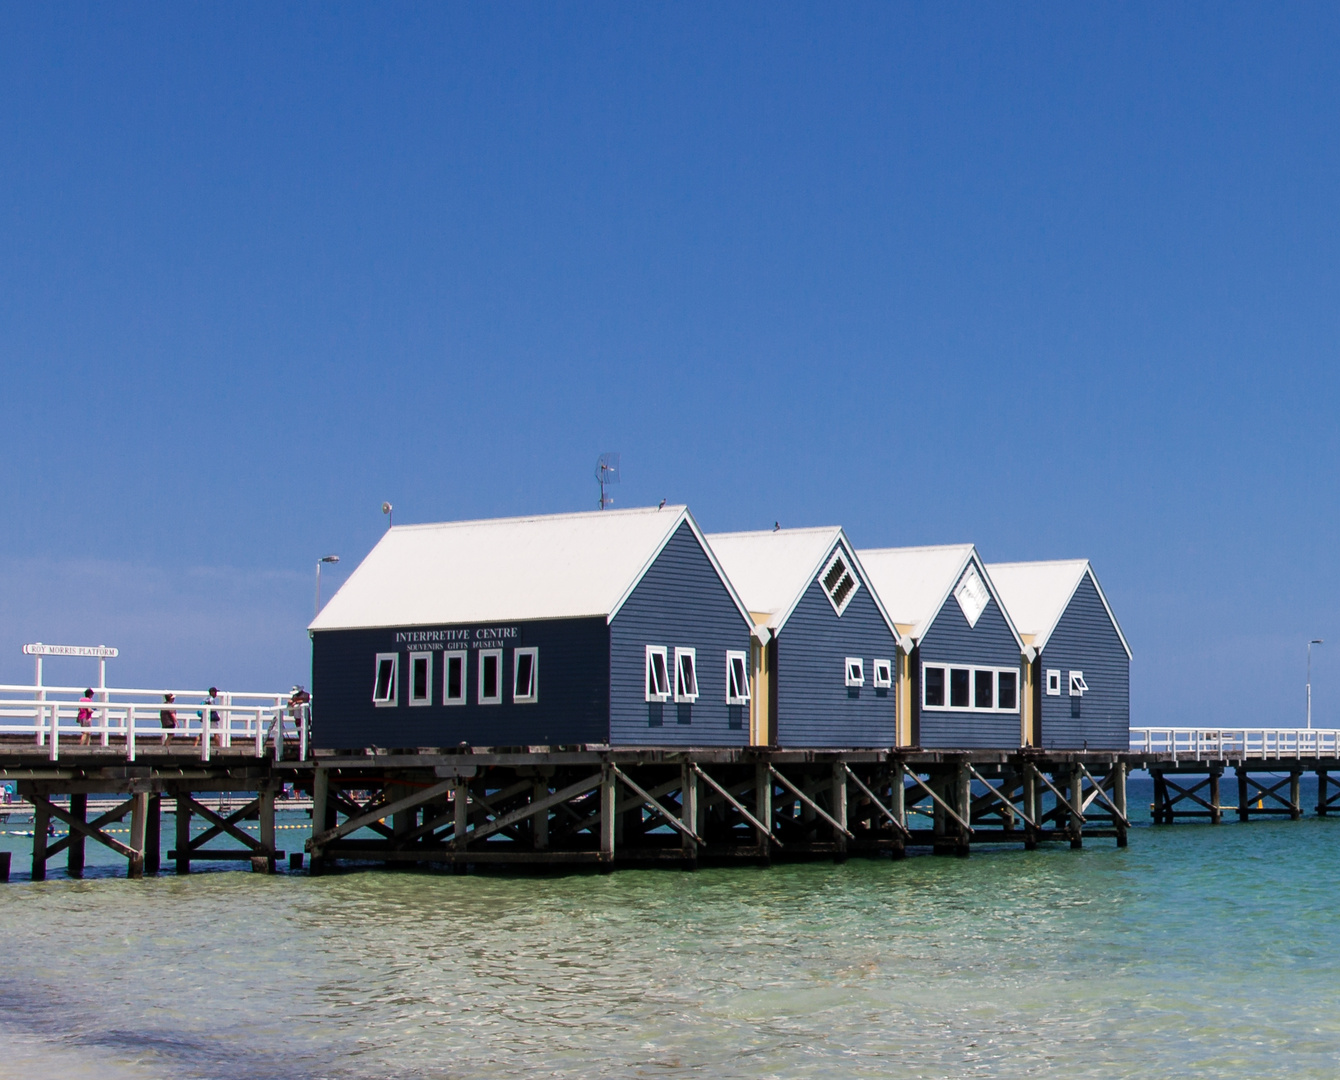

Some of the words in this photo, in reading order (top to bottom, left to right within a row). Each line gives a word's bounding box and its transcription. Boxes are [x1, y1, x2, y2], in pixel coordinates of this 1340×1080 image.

[396, 630, 470, 642] INTERPRETIVE
[476, 627, 518, 639] CENTRE
[32, 645, 46, 653] ROY
[49, 646, 76, 655] MORRIS
[79, 647, 115, 656] PLATFORM
[406, 642, 443, 651] SOUVENIRS
[447, 641, 468, 650] GIFTS
[472, 640, 504, 649] MUSEUM
